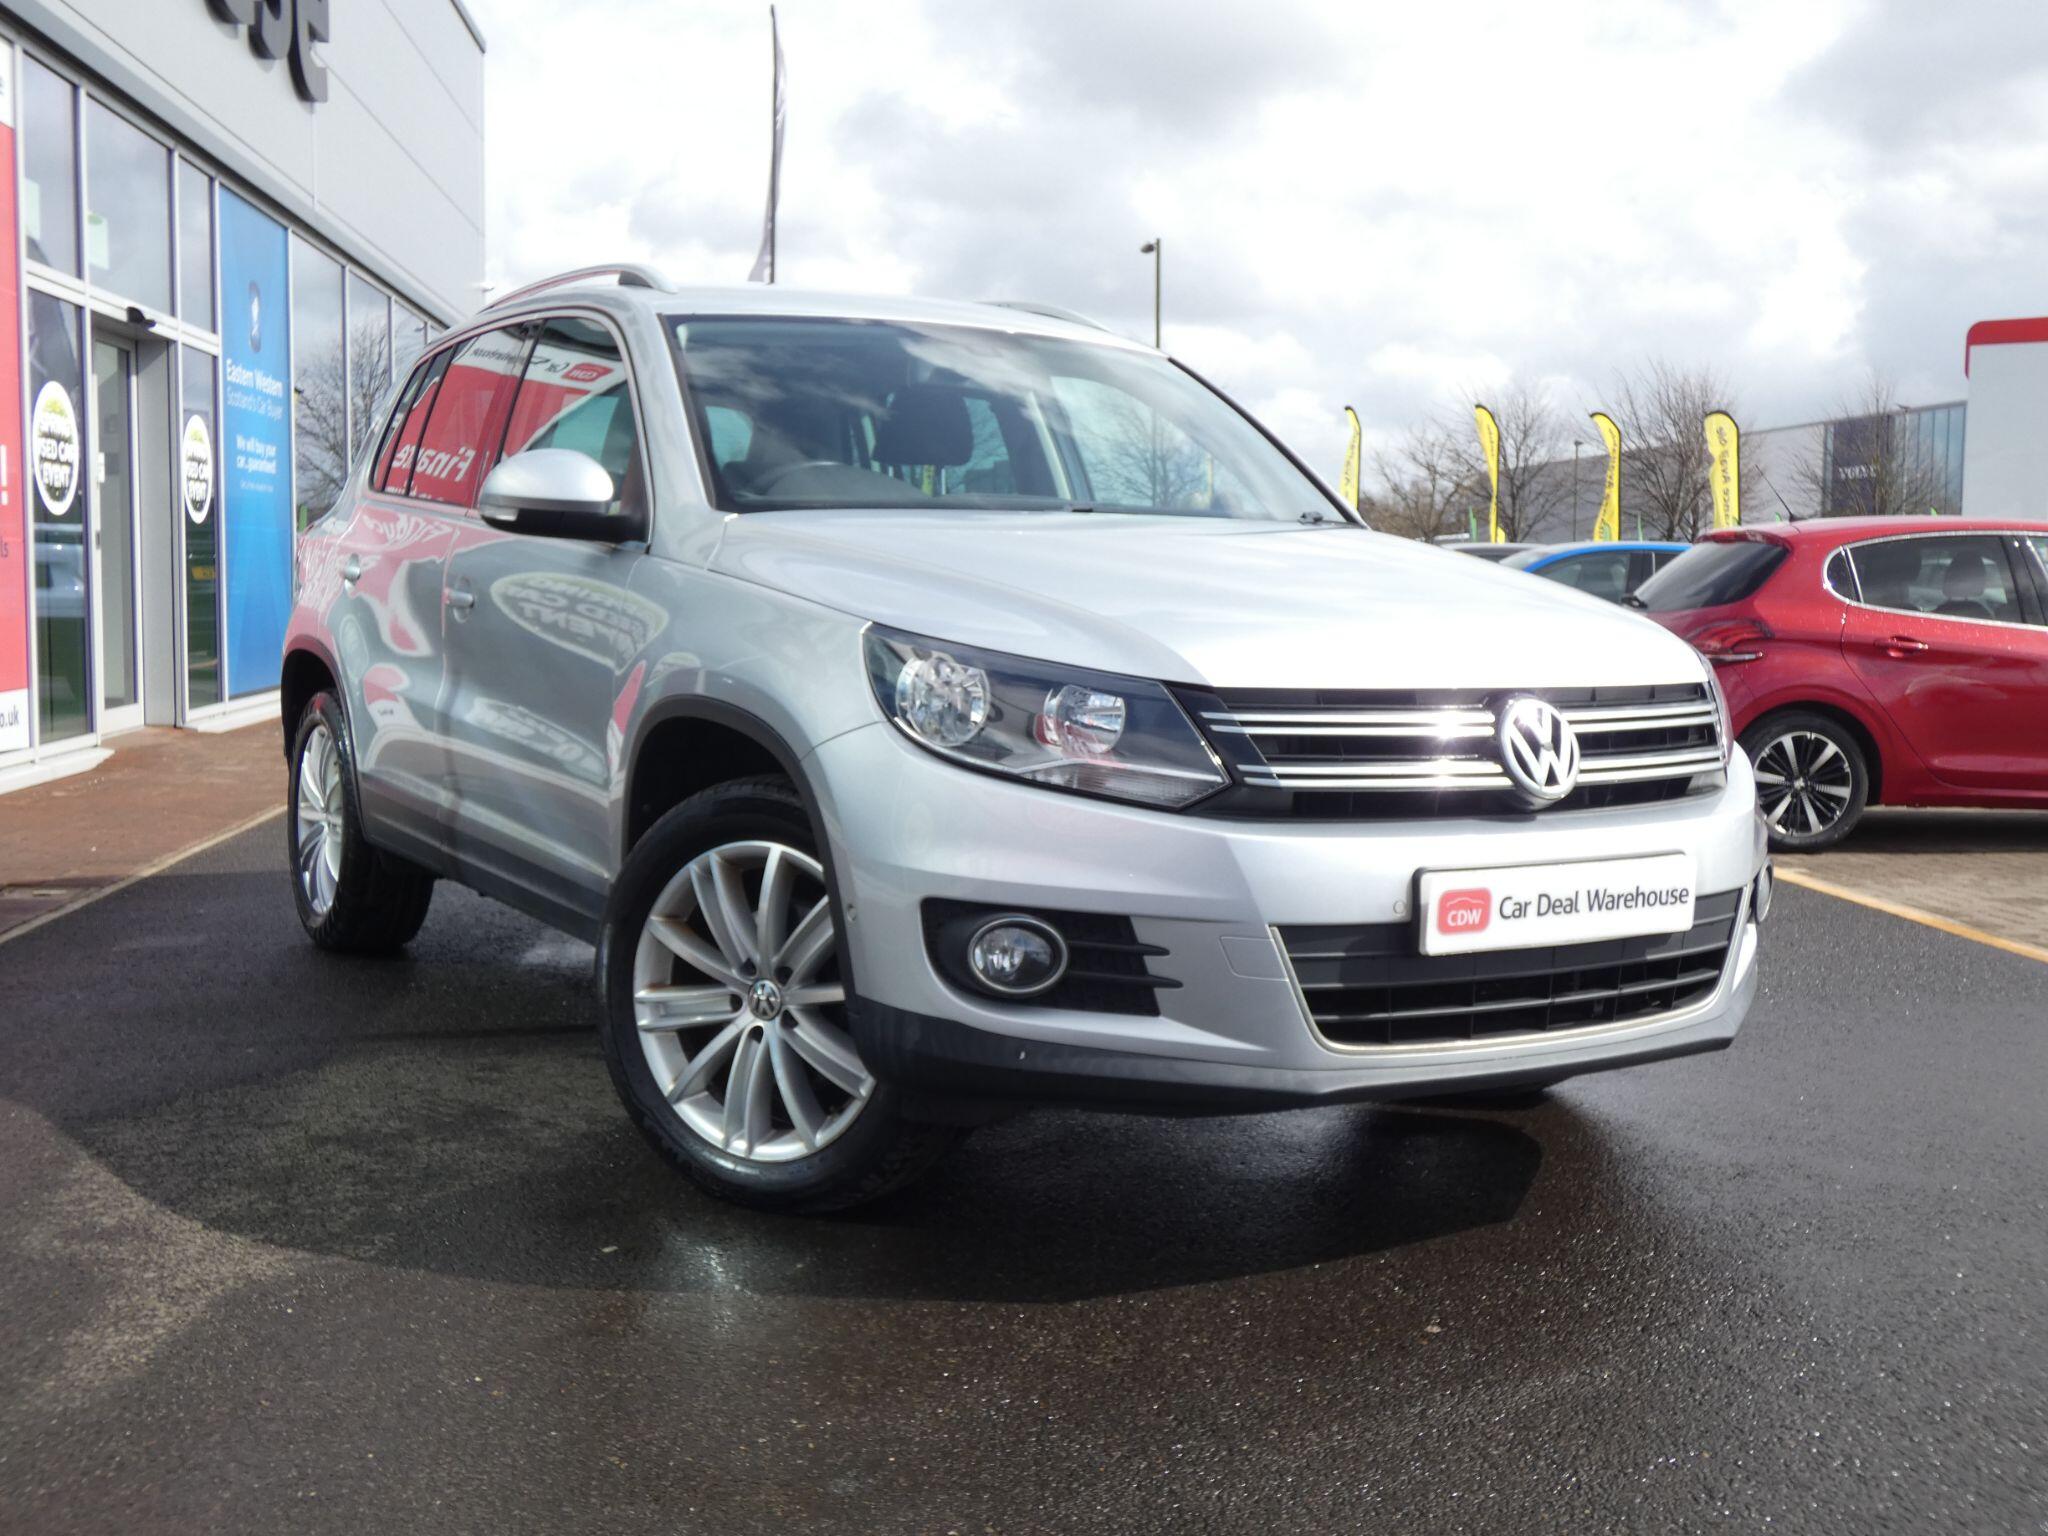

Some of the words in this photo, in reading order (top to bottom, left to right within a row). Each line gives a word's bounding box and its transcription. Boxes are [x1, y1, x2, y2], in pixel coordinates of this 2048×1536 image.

[1499, 896, 1532, 920] Car
[1537, 890, 1581, 917] Deal
[1587, 885, 1690, 912] Warehouse
[1447, 909, 1482, 927] CDW
